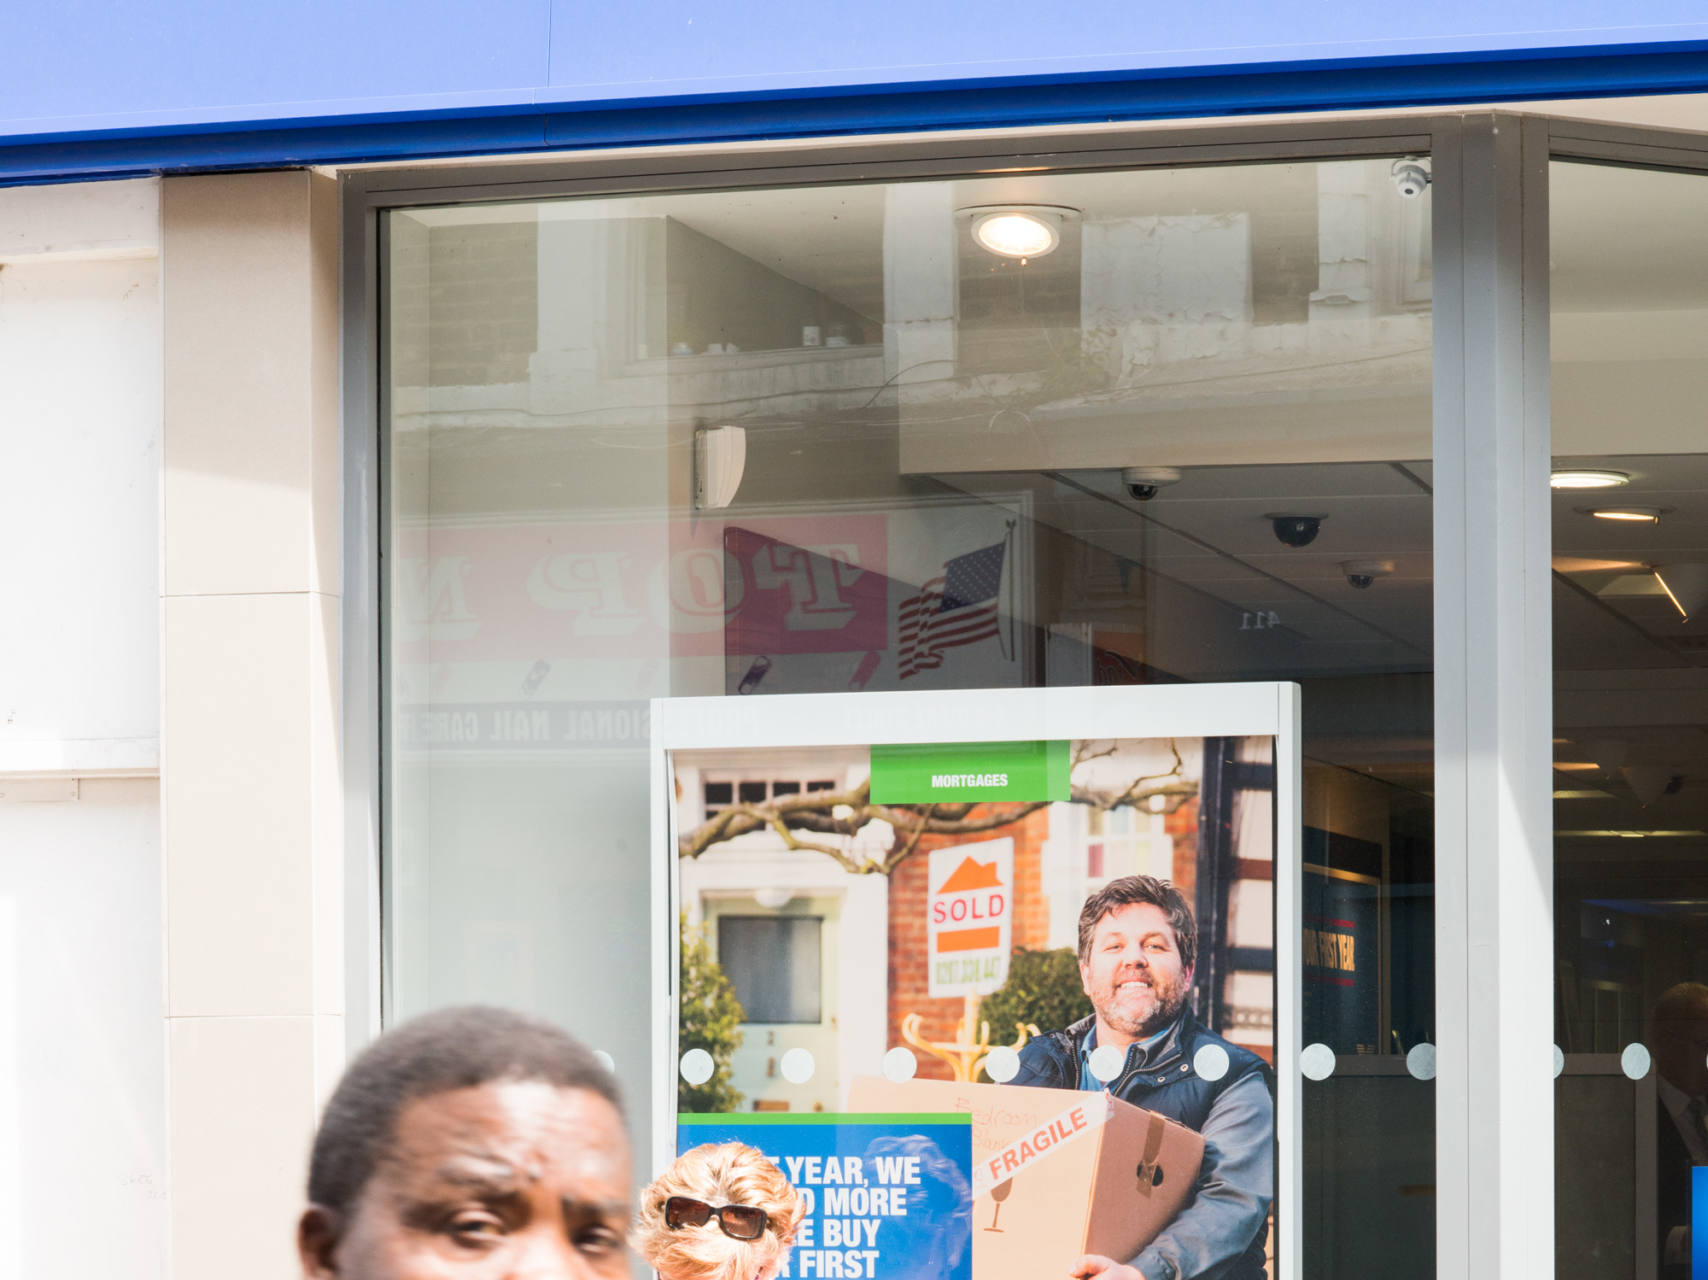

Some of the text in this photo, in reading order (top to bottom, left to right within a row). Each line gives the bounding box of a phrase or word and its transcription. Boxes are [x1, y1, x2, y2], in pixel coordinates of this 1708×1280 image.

[931, 774, 1009, 788] MORTGAGES
[933, 893, 1005, 924] SOLD
[988, 1107, 1088, 1180] FRAGILE
[785, 1156, 921, 1188] YEAR, WE
[823, 1187, 908, 1216] MORE
[823, 1219, 881, 1247] BUY
[799, 1250, 880, 1279] FIRST
